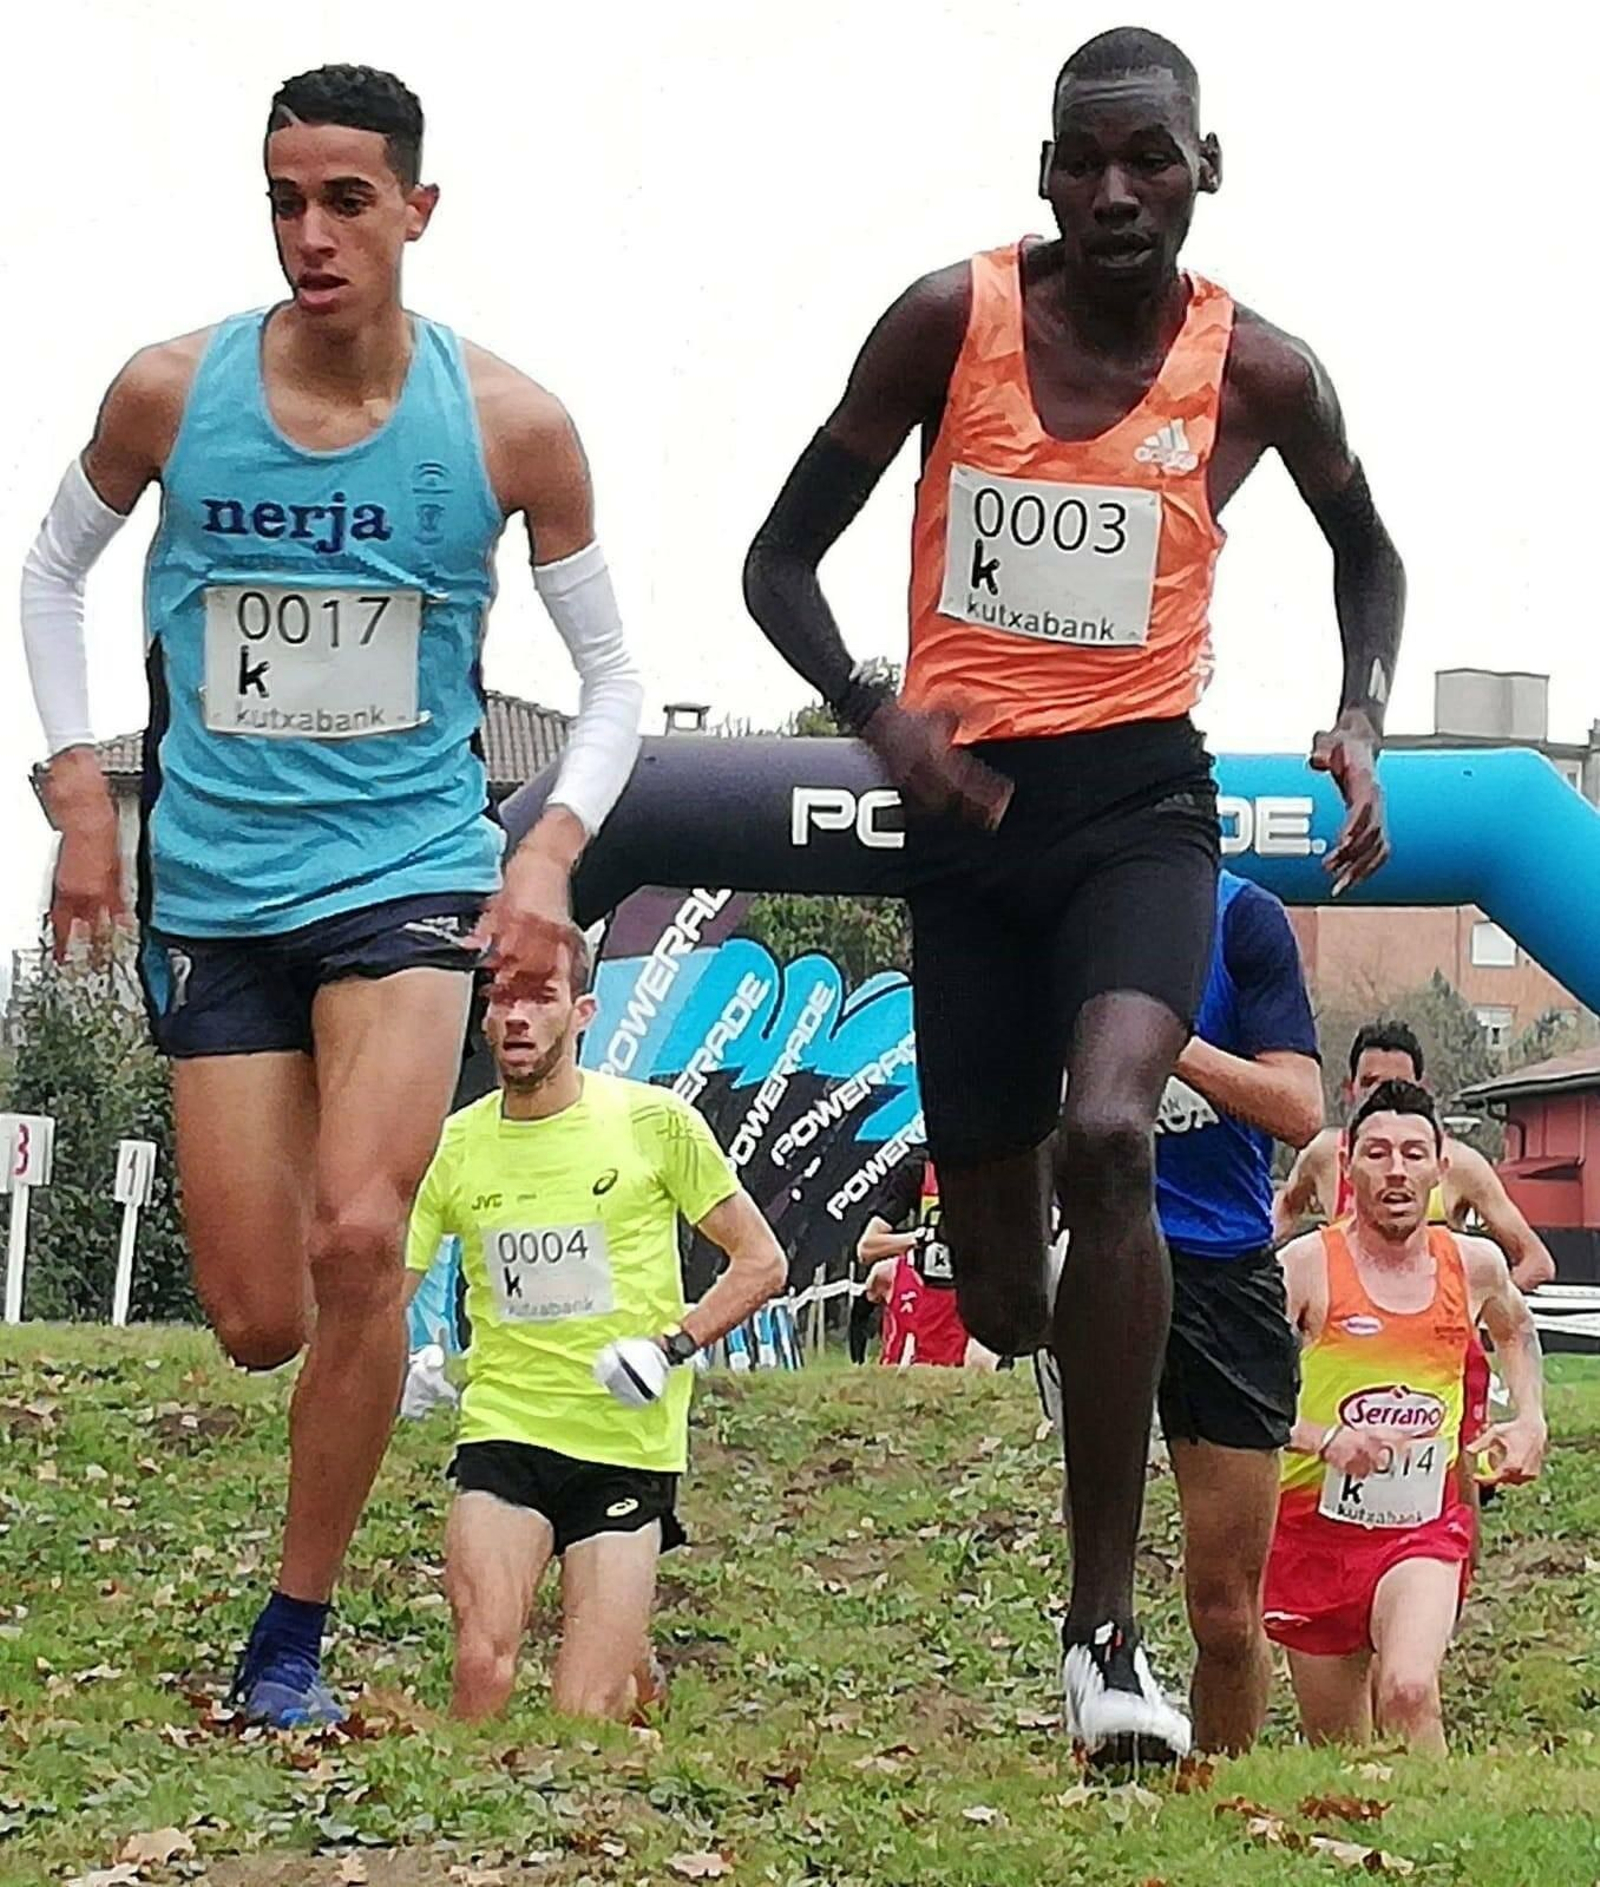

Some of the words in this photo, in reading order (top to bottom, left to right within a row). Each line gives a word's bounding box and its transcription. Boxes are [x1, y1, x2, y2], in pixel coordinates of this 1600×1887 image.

[201, 491, 391, 554] nerja
[973, 486, 1128, 555] 0003
[970, 538, 1001, 596] k
[236, 590, 391, 648] 0017
[966, 593, 1116, 641] kutxabank
[238, 645, 270, 698] k
[234, 704, 386, 732] kutxabank
[672, 971, 773, 1105] ERADE
[497, 1228, 589, 1264] 0004
[503, 1265, 523, 1298] k
[1351, 1398, 1442, 1426] Serrano
[1372, 1444, 1436, 1478] 014
